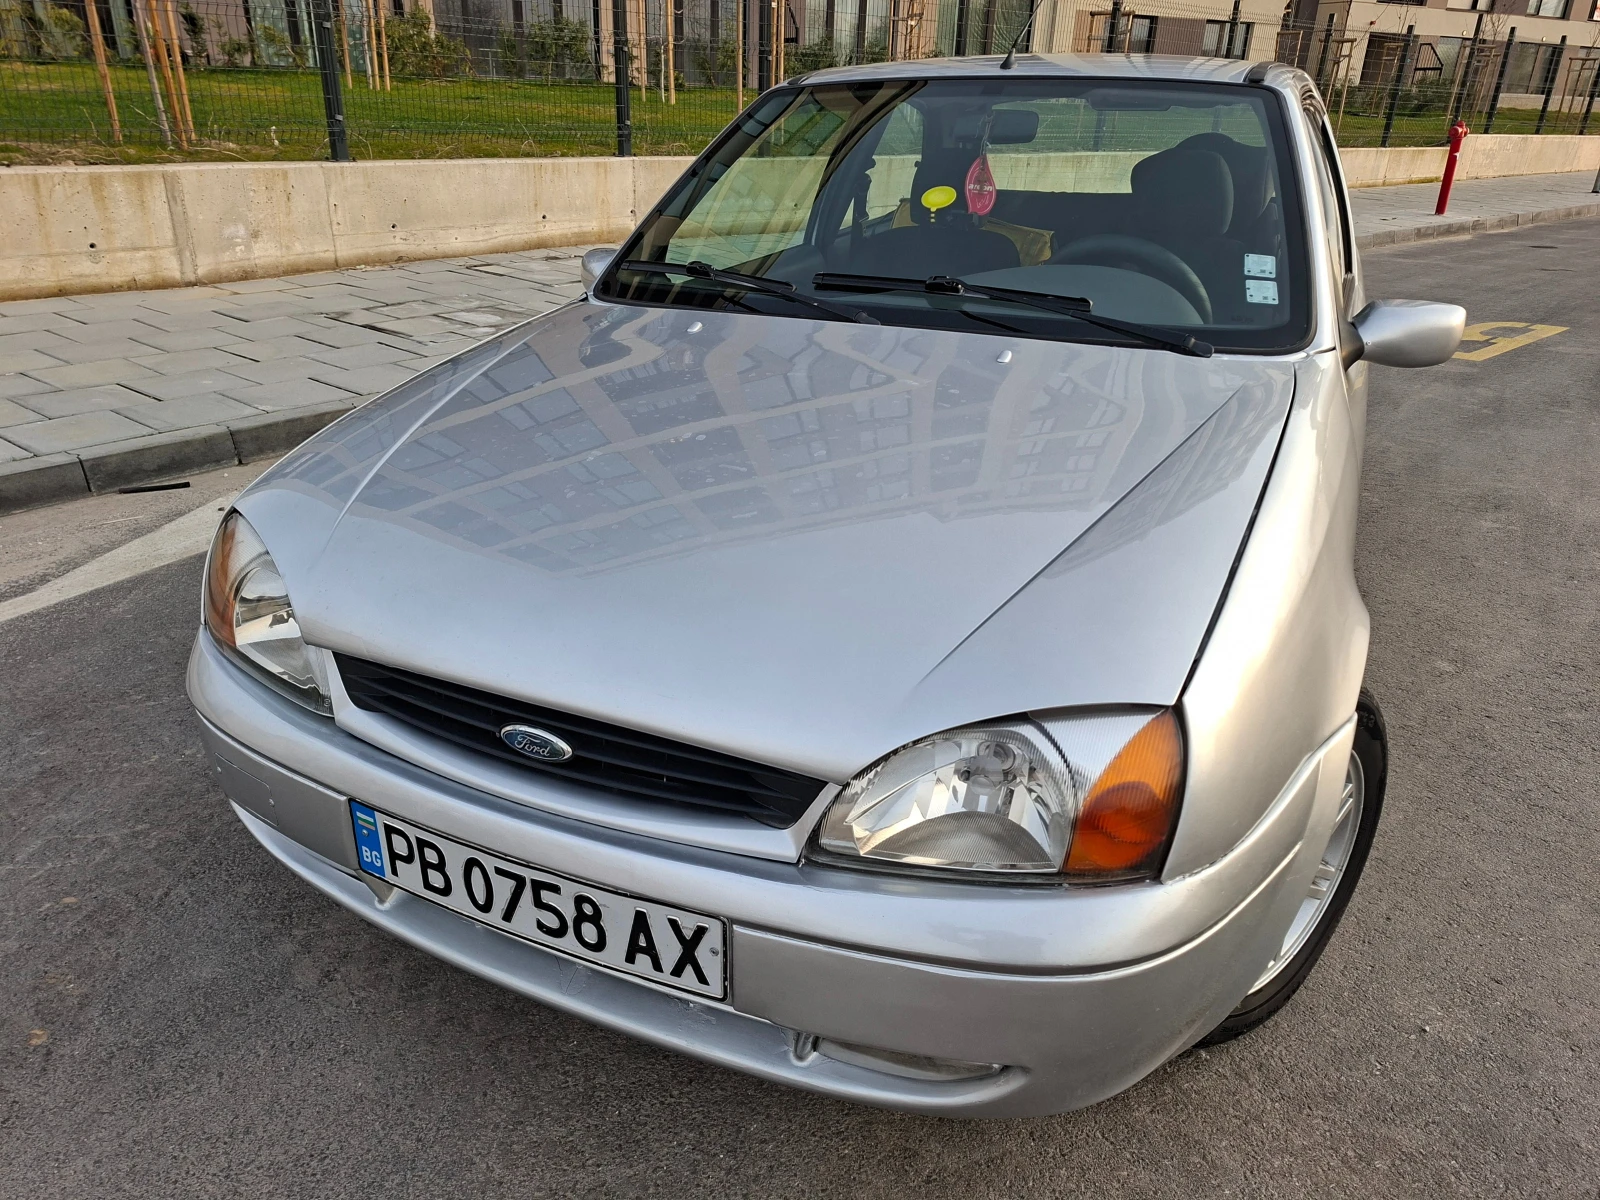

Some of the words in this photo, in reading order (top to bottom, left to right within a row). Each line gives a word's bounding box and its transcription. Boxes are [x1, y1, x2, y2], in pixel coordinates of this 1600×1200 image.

[514, 734, 550, 757] Ford
[361, 846, 382, 867] BG
[383, 821, 453, 898] PB
[463, 857, 607, 952] 0758
[624, 908, 711, 986] AX
